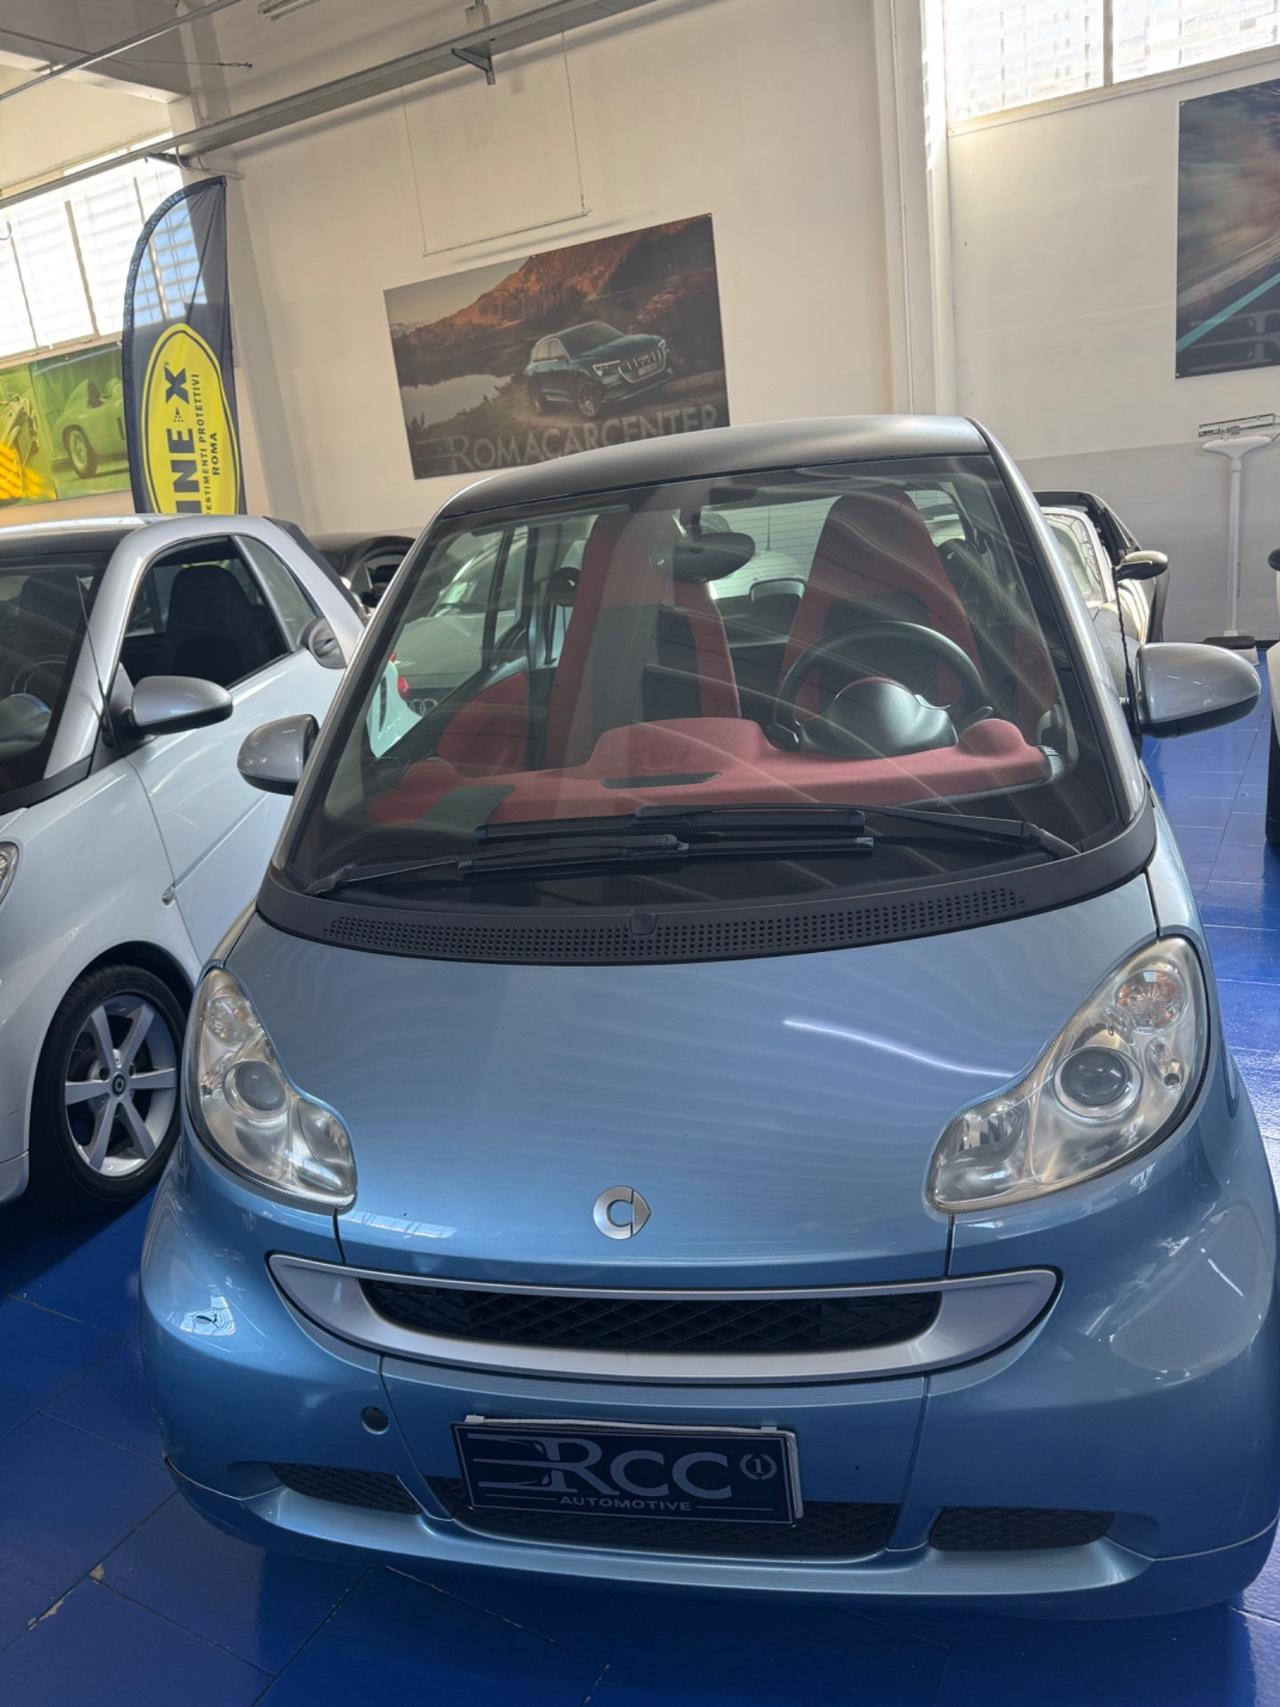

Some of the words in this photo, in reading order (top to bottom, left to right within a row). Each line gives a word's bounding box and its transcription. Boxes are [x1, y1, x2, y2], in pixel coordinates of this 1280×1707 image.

[163, 366, 203, 513] INE-X
[191, 374, 208, 443] PROTETTIVI
[200, 445, 213, 514] ESTIMENTI
[210, 432, 221, 475] ROMA
[560, 1494, 692, 1512] AUTOMOTIVE
